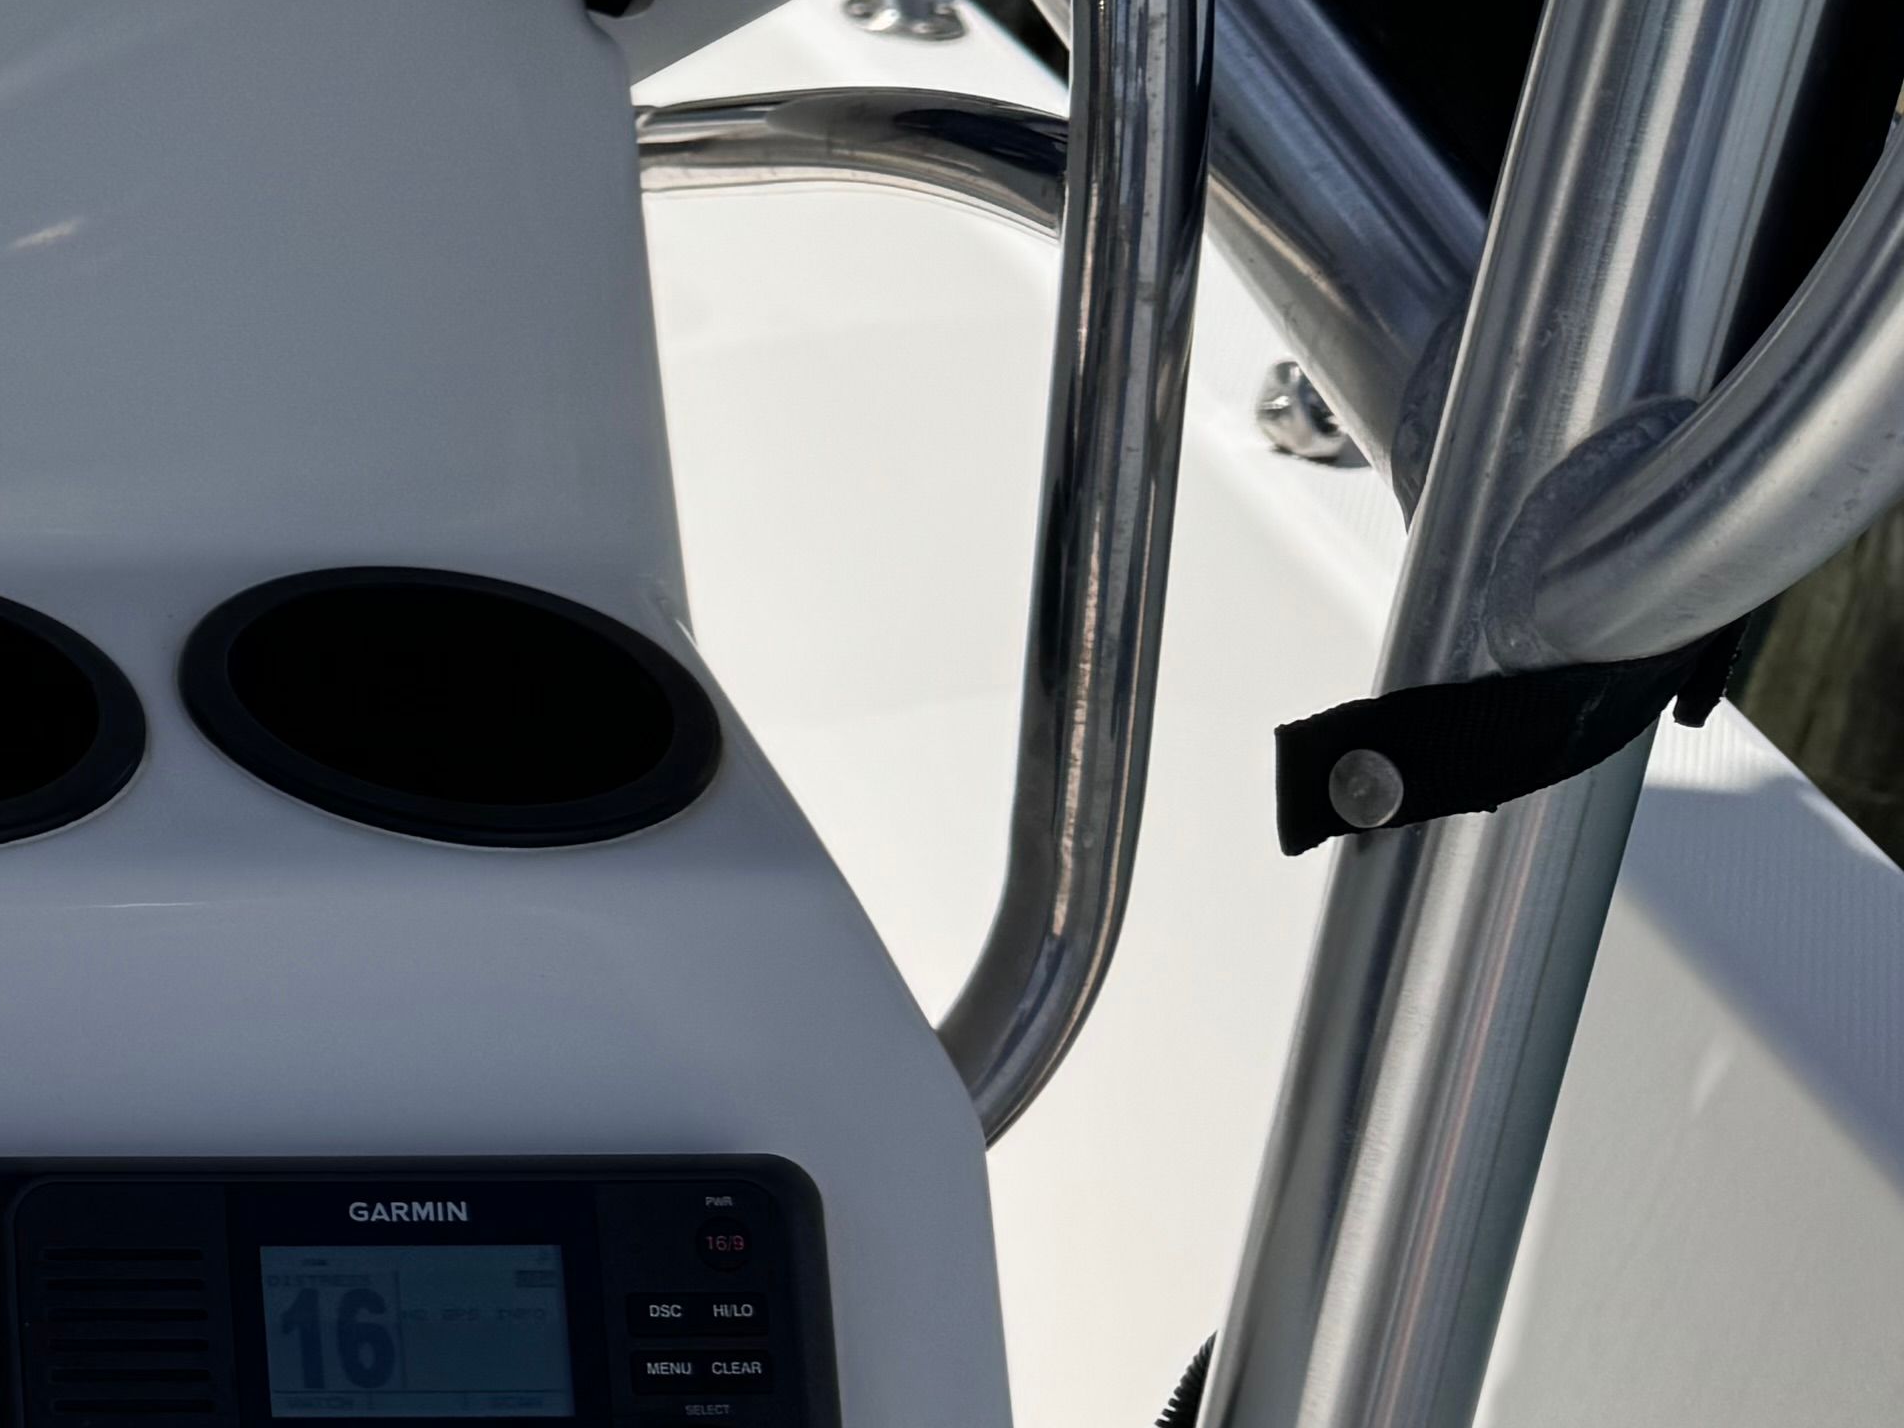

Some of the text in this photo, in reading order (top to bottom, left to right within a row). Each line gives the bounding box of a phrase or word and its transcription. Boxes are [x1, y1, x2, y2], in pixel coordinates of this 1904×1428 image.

[704, 1195, 734, 1207] PWR
[348, 1201, 469, 1223] GARMIN
[705, 1234, 746, 1253] 16/9
[648, 1303, 755, 1319] DSC HI/LO
[281, 1287, 396, 1390] 16
[645, 1360, 763, 1376] MENU CLEAR
[684, 1403, 731, 1416] SELECT
